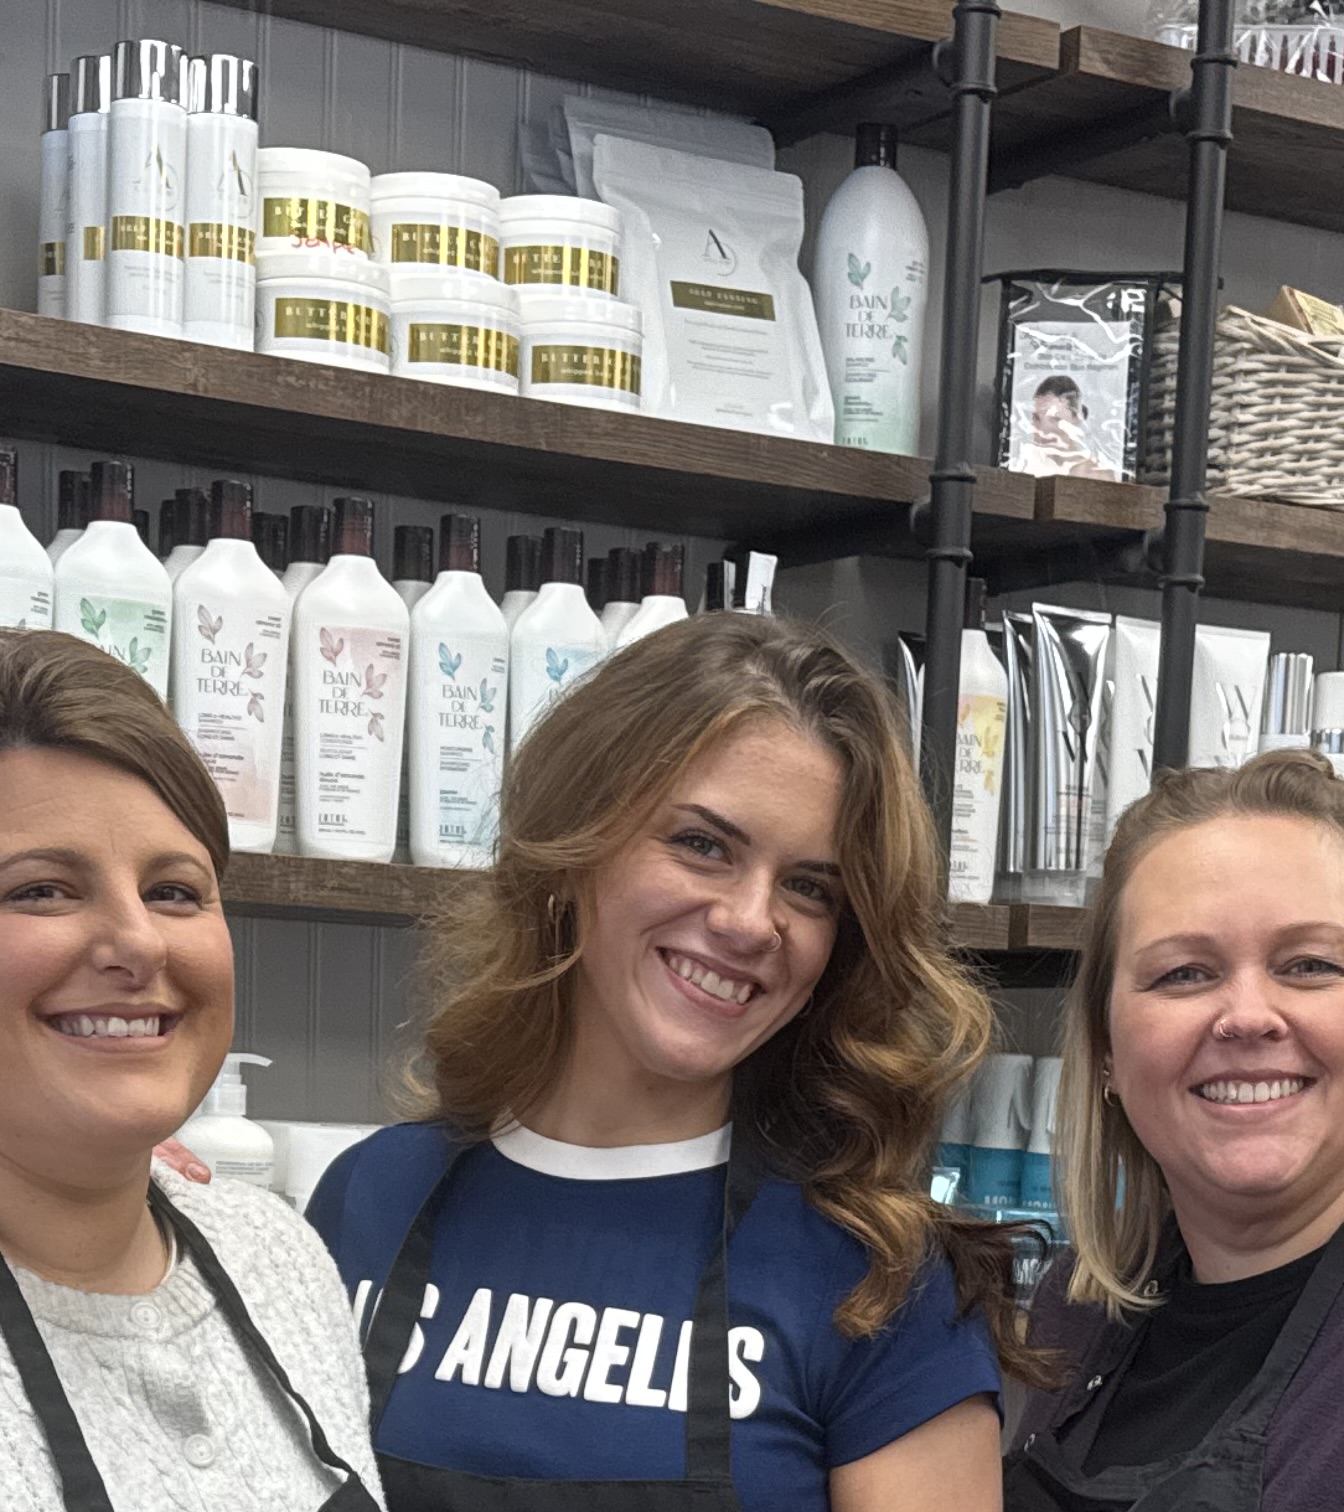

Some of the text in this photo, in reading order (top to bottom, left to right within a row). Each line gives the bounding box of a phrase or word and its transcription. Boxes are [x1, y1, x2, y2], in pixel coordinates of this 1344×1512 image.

[849, 293, 888, 311] BAIN
[845, 322, 892, 340] TERRE
[201, 648, 242, 667] BAIN
[211, 665, 228, 679] DE
[322, 669, 362, 688] BAIN
[197, 678, 248, 697] TERRE
[332, 686, 349, 700] DE
[442, 684, 478, 702] BAIN
[319, 699, 367, 717] TERRE
[451, 700, 466, 713] DE
[439, 712, 483, 730] TERRE
